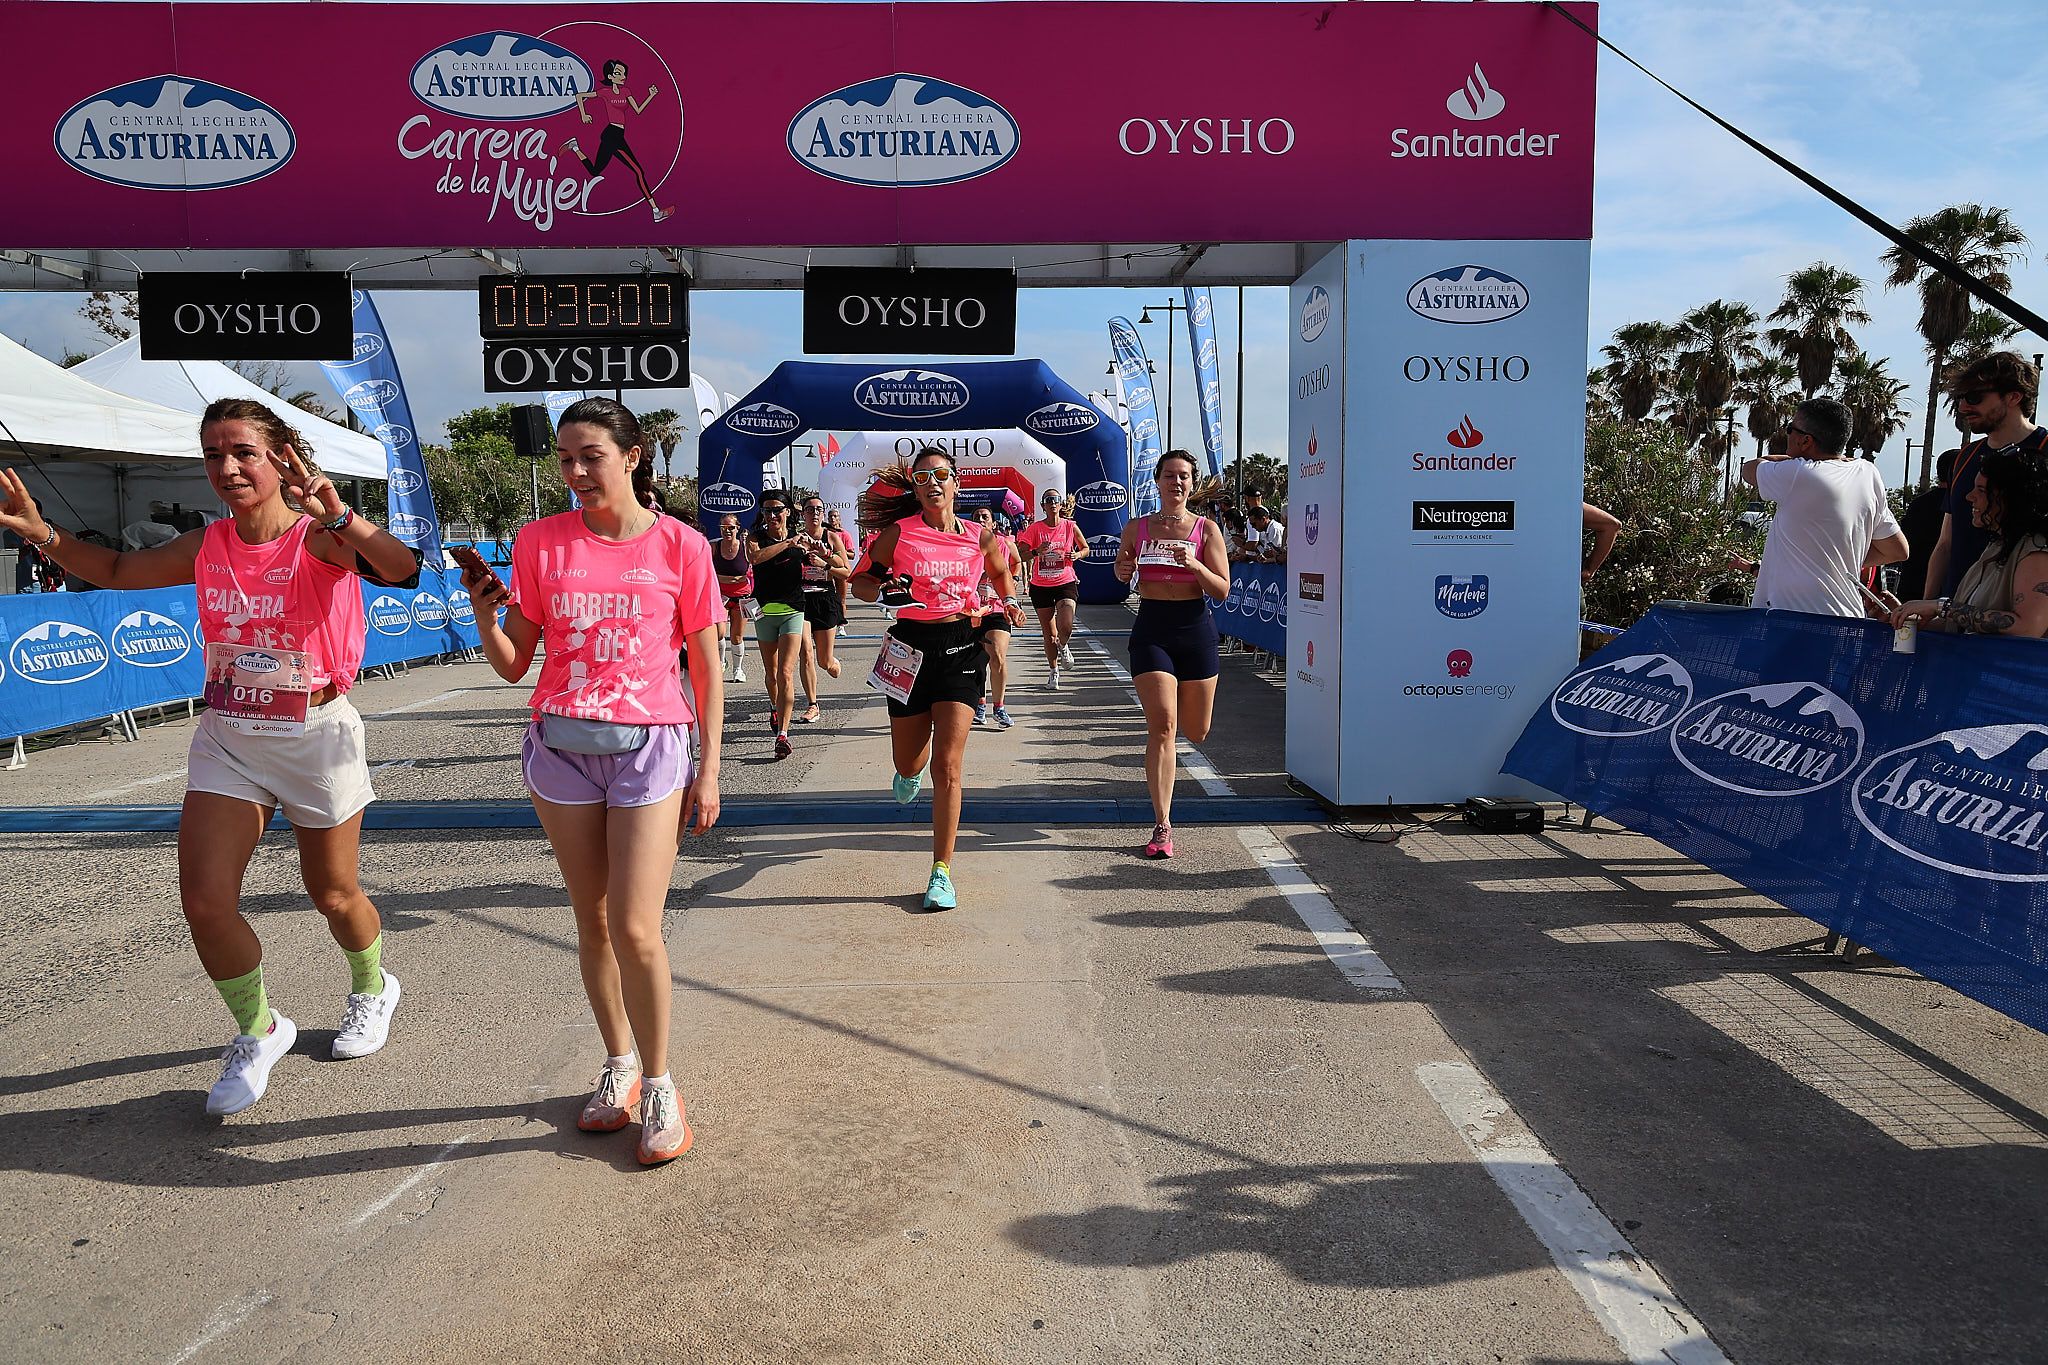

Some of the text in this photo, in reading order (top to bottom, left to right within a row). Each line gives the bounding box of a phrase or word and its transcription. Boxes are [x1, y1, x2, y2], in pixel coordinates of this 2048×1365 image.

[452, 62, 574, 71] CENTRAL LECHERA
[425, 64, 579, 98] ASTURIANA
[109, 116, 268, 127] CENTRAL LECHERA
[841, 113, 994, 125] CENTRAL LECHERA
[75, 118, 278, 160] ASTURIANA
[398, 115, 548, 160] Carrera
[806, 116, 1002, 158] ASTURIANA
[1118, 118, 1296, 155] OYSHO
[1390, 128, 1559, 158] Santander
[436, 162, 490, 194] de la
[487, 155, 605, 231] Mujer
[494, 283, 672, 327] 00:36:00
[1415, 286, 1520, 309] ASTURIANA
[174, 303, 321, 334] OYSHO
[838, 295, 986, 329] OYSHO
[1302, 306, 1328, 334] ASTURIANA
[494, 344, 679, 385] OYSHO
[1403, 355, 1530, 383] OYSHO
[1299, 364, 1330, 400] OYSHO
[862, 384, 961, 406] ASTURIANA
[731, 413, 794, 429] ASTURIANA
[1032, 414, 1095, 429] ASTURIANA
[834, 461, 865, 469] OYSHO
[956, 467, 1001, 476] Santander
[1023, 458, 1054, 466] OYSHO
[1300, 459, 1326, 479] Santander
[1412, 452, 1517, 471] Santander
[702, 493, 752, 507] ASTURIANA
[1077, 492, 1126, 505] ASTURIANA
[1420, 507, 1508, 527] Neutrogena
[549, 569, 587, 580] OYSHO
[1437, 584, 1486, 608] Marlene
[373, 611, 410, 627] ASTURIANA
[120, 636, 187, 657] ASTURIANA
[594, 627, 624, 662] DE
[20, 645, 106, 674] ASTURIANA
[237, 658, 278, 670] ASTURIANA
[882, 661, 901, 677] 016
[233, 686, 274, 704] 016
[575, 686, 599, 707] LA
[1403, 684, 1516, 700] octopus energy
[1598, 675, 1681, 700] CENTRAL LECHERA
[1558, 675, 1670, 726] ASTURIANA
[261, 724, 294, 733] Santander
[1731, 708, 1849, 748] CENTRAL LECHERA
[1678, 705, 1838, 783] ASTURIANA
[1931, 762, 2014, 792] CENTRAL
[1861, 757, 2048, 851] ASTURIA
